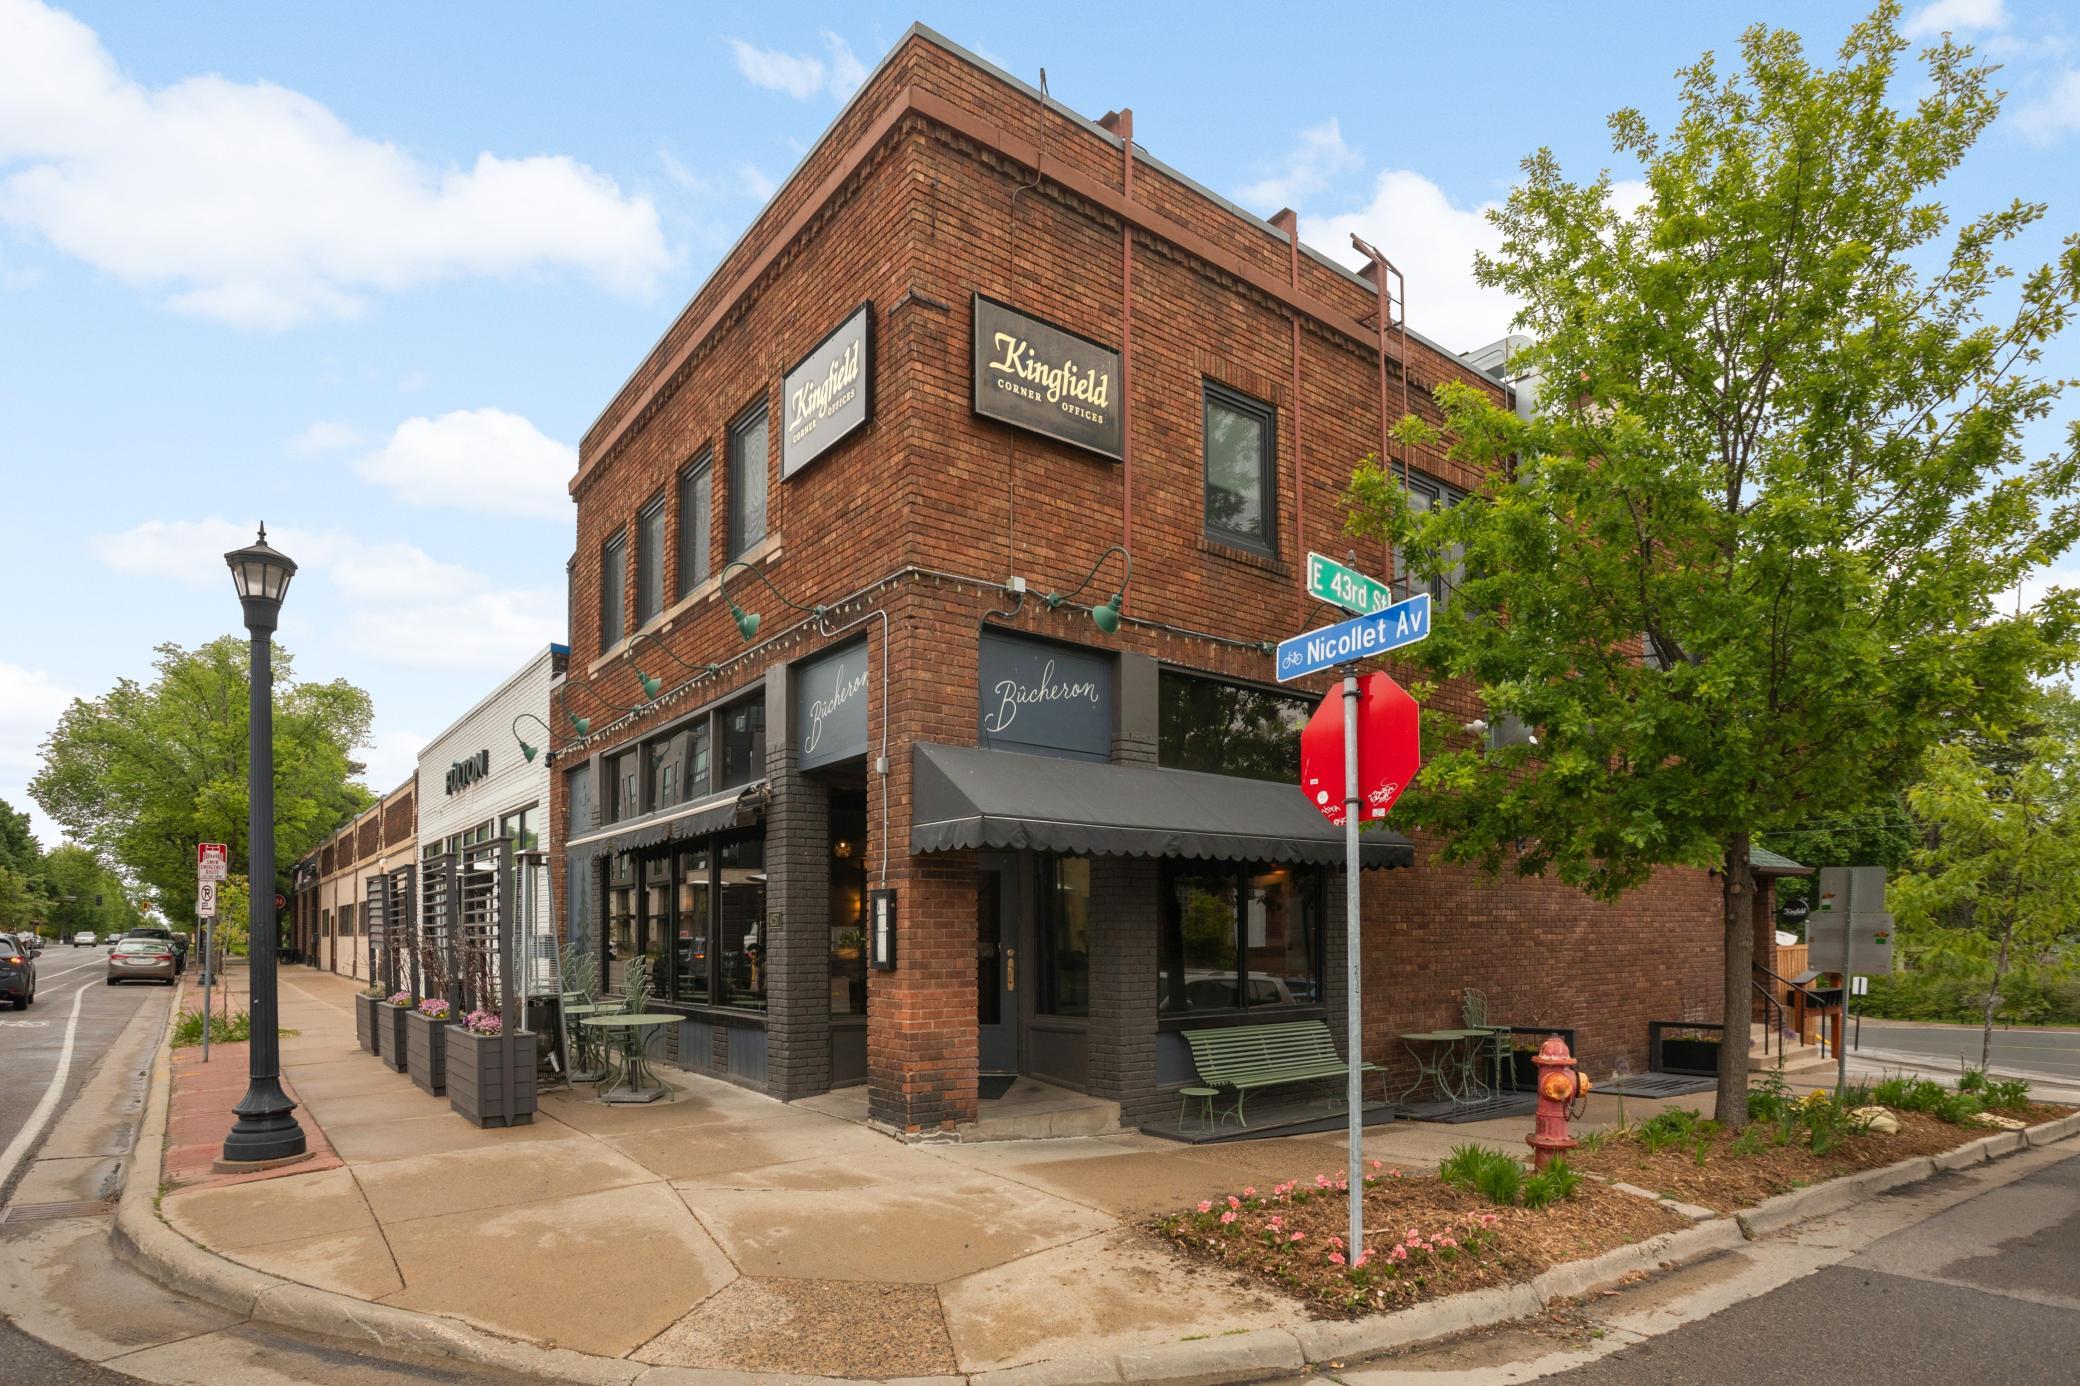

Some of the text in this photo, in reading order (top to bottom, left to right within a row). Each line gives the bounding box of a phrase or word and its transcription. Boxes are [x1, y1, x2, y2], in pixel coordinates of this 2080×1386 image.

[788, 338, 860, 432] Kingfield
[988, 332, 1109, 409] Kingfield
[792, 389, 855, 443] CORNER OFFICES
[997, 378, 1104, 424] CORNER OFFICES
[1313, 562, 1388, 612] E 43rd St
[1307, 610, 1422, 665] Nicollet Av
[984, 659, 1099, 732] Bûcheron
[446, 749, 489, 796] FULTON
